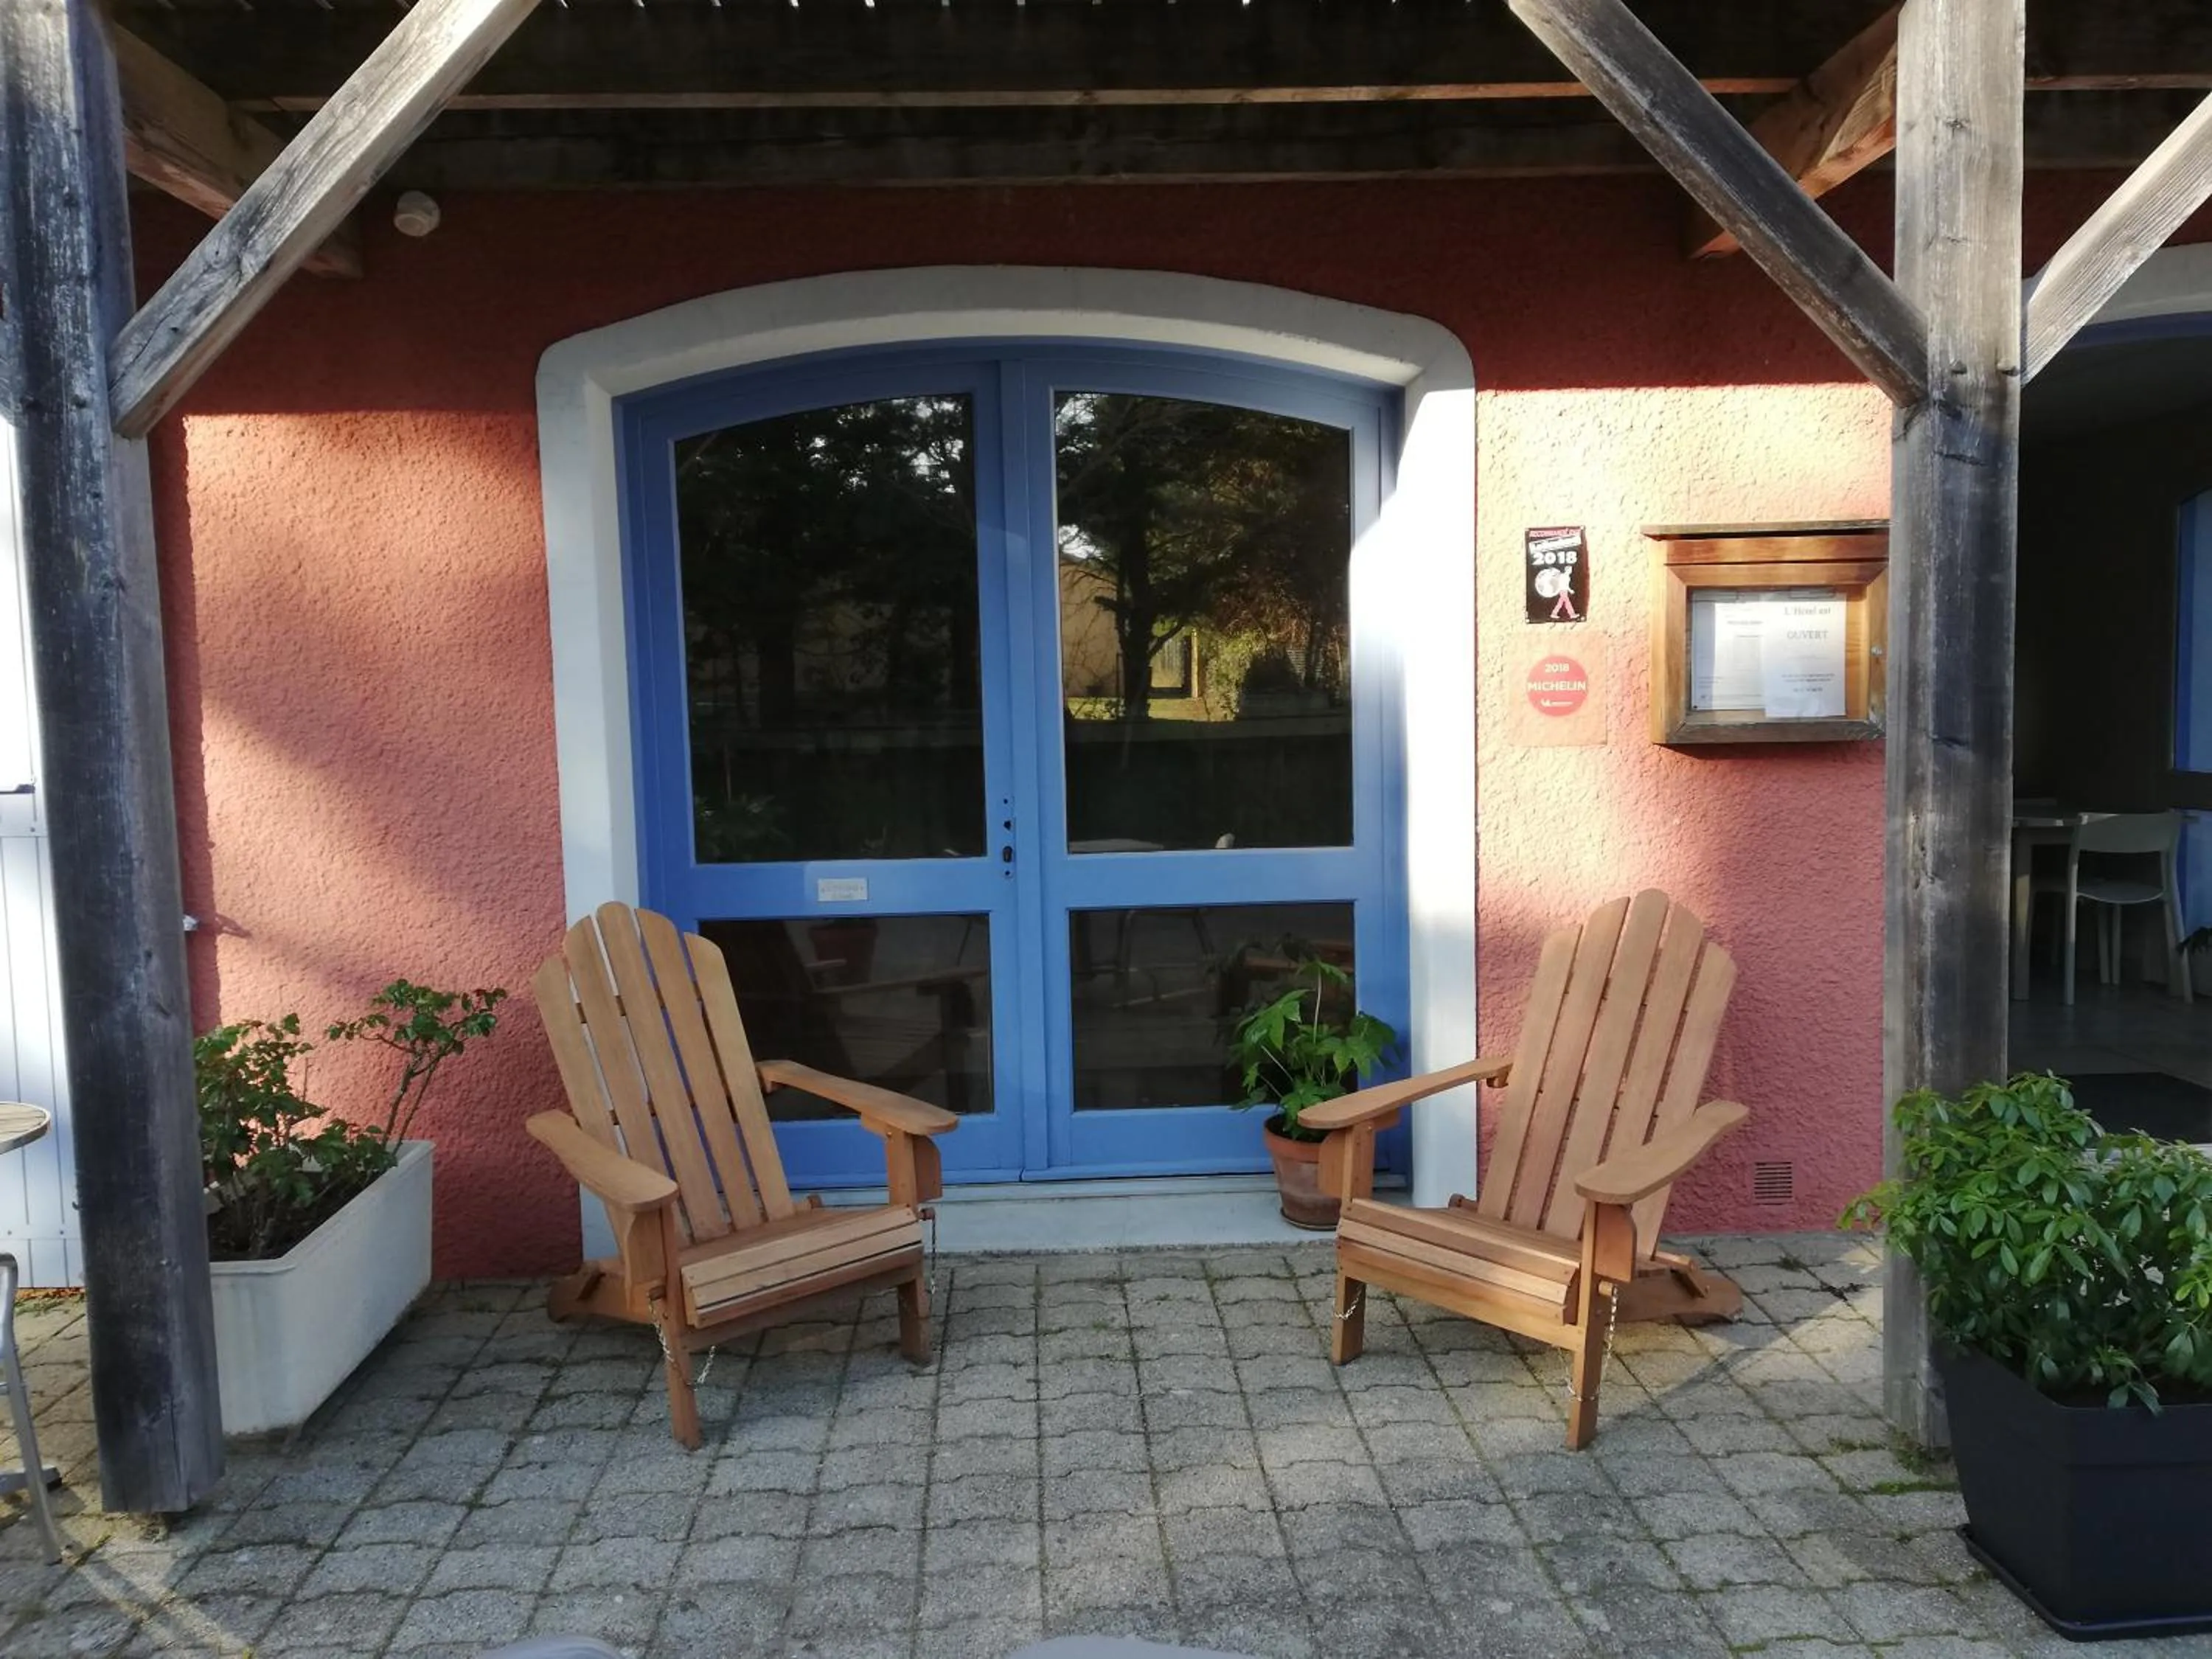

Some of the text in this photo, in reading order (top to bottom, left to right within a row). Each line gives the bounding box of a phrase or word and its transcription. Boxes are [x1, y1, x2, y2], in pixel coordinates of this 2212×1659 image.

[1532, 551, 1577, 565] 2018
[1787, 630, 1829, 640] OUVERT
[1545, 663, 1570, 673] 2018
[1528, 681, 1586, 692] MICHELIN
